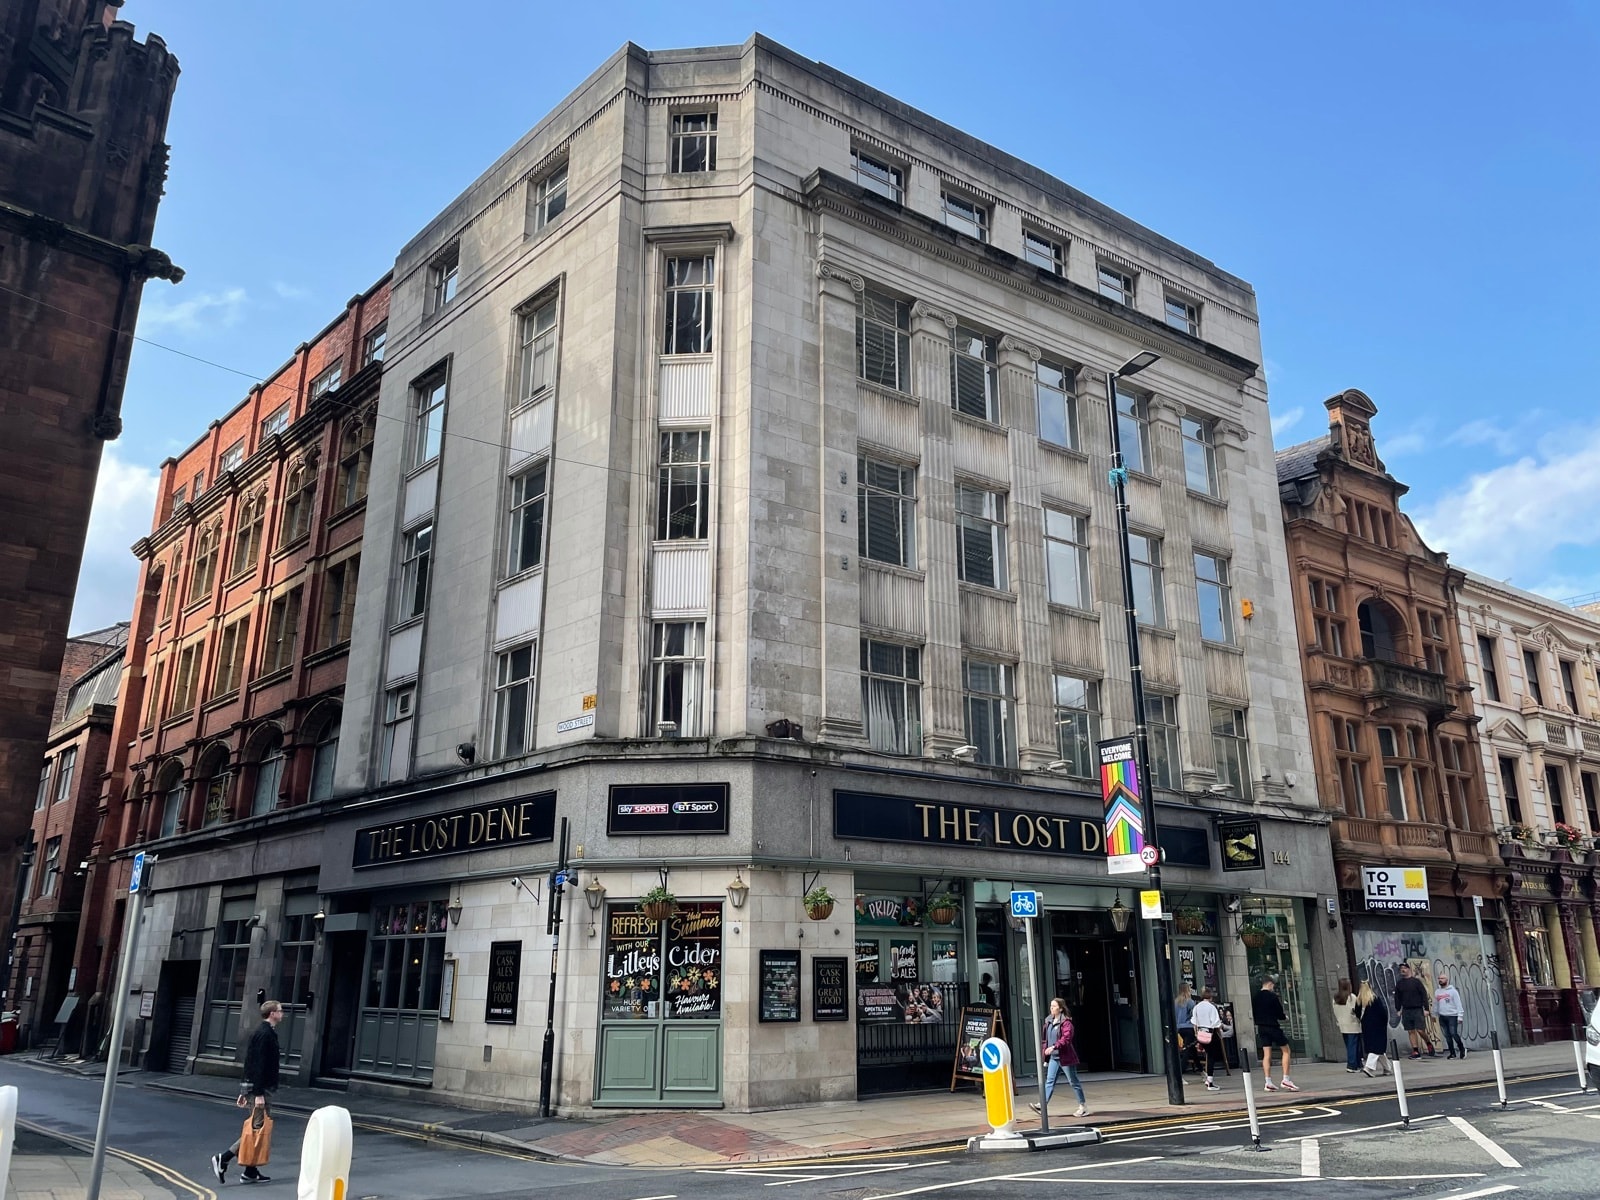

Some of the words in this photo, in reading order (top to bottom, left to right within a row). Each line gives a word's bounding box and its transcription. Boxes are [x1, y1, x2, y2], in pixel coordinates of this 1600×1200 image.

[558, 722, 574, 730] WOOD
[574, 716, 592, 727] STREET
[1100, 743, 1132, 756] EVERYONE
[1102, 751, 1132, 763] WELCOME
[620, 806, 632, 815] sky
[634, 805, 666, 813] SPORTS
[691, 803, 713, 812] Sport
[368, 825, 405, 860] THE
[409, 814, 465, 853] LOST
[467, 802, 534, 845] DENE
[915, 803, 982, 842] THE
[994, 811, 1070, 850] LOST
[1142, 850, 1156, 860] 20
[1271, 849, 1291, 865] 144
[1366, 871, 1389, 883] TO
[1367, 884, 1397, 897] LET
[868, 900, 901, 920] PRIDE
[1387, 901, 1404, 909] 602
[612, 916, 658, 935] REFRESH
[670, 916, 721, 941] Summer
[616, 942, 633, 952] WITH
[635, 940, 649, 948] OUR
[668, 942, 719, 967] Cider
[1179, 950, 1194, 961] FOOD
[496, 956, 515, 967] CASK
[608, 950, 660, 978] Lilley's
[497, 967, 514, 977] ALES
[820, 969, 841, 977] CASK
[900, 968, 917, 979] ALES
[821, 976, 840, 985] ALES
[493, 982, 514, 992] GREAT
[818, 988, 842, 996] GREAT
[494, 992, 512, 1003] FOOD
[820, 996, 841, 1005] FOOD
[676, 1000, 715, 1015] Available!
